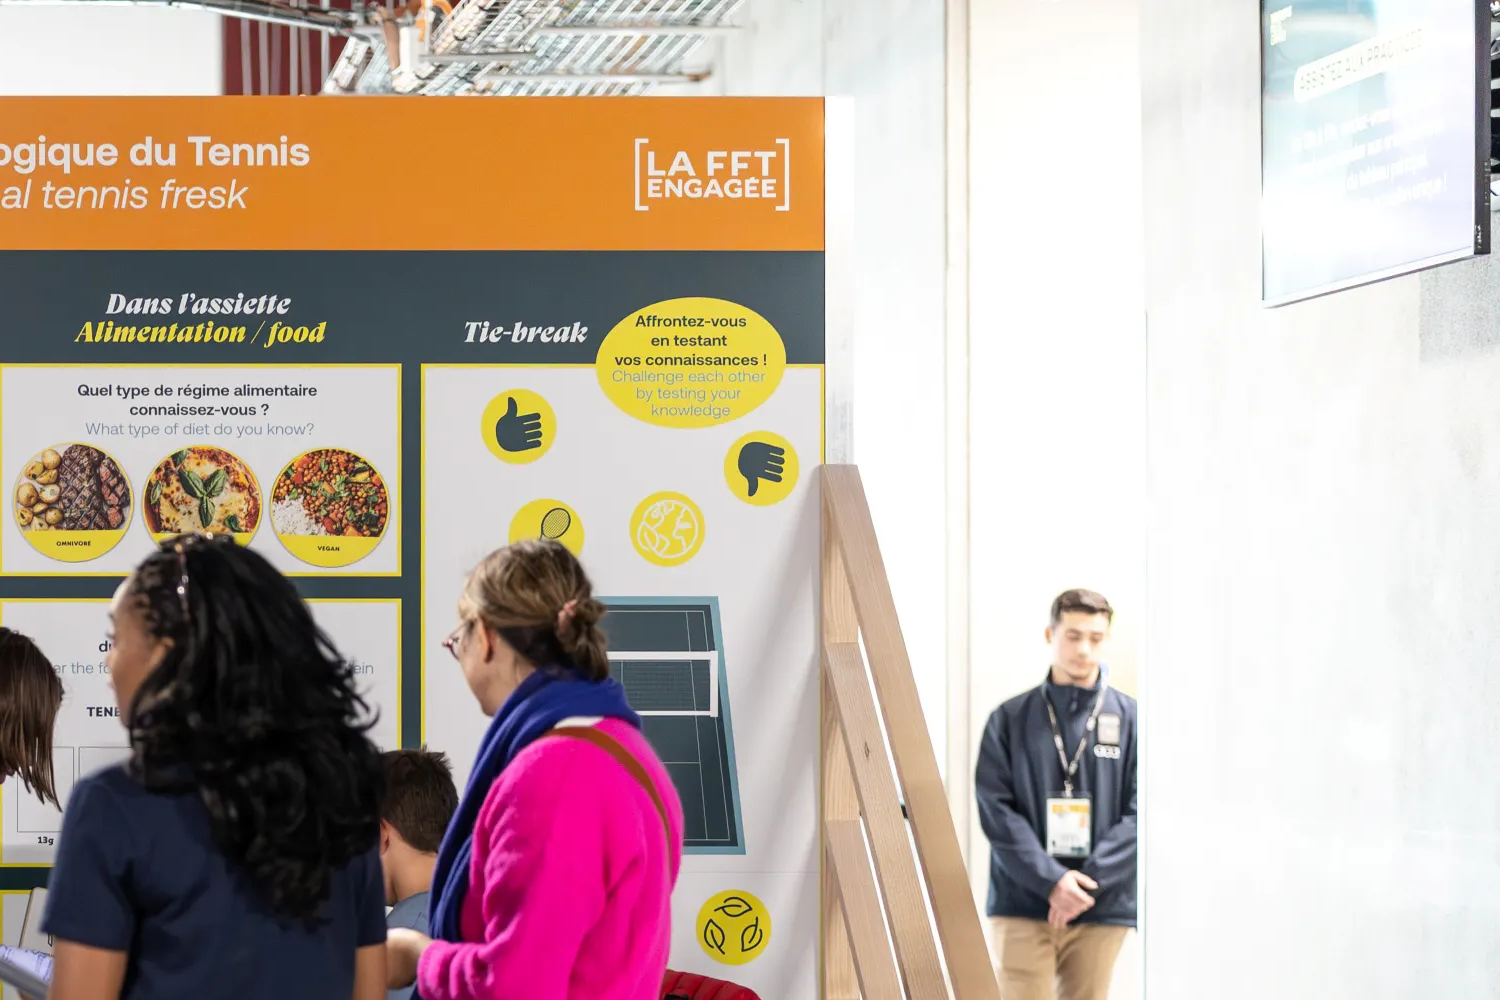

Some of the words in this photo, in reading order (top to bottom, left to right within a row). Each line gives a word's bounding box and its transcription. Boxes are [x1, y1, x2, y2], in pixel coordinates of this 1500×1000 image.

[129, 135, 176, 167] du
[187, 135, 310, 167] Tennis
[647, 151, 697, 176] LA
[706, 151, 777, 176] FFT
[41, 178, 149, 210] tennis
[160, 178, 249, 210] fresk
[647, 176, 777, 198] ENGAGÉE
[106, 293, 173, 316] Dans
[634, 314, 747, 328] Affrontez-vous
[75, 322, 246, 345] Alimentation
[264, 321, 326, 348] food
[464, 321, 589, 343] Tie-break
[650, 337, 670, 347] en
[673, 334, 728, 347] testant
[614, 356, 642, 366] vos
[645, 353, 759, 366] connaissances
[611, 369, 684, 384] Challenge
[688, 369, 724, 383] each
[728, 370, 766, 383] other
[77, 383, 113, 397] Quel
[115, 384, 150, 400] type
[153, 384, 174, 397] de
[177, 383, 230, 400] régime
[233, 383, 318, 397] alimentaire
[636, 387, 653, 403] by
[657, 387, 707, 402] testing
[710, 389, 742, 402] your
[129, 402, 257, 416] connaissez-vous
[260, 403, 270, 416] ?
[651, 403, 730, 418] knowledge
[85, 422, 125, 436] What
[127, 423, 160, 438] type
[164, 422, 179, 436] of
[182, 422, 210, 436] diet
[213, 422, 233, 436] do
[236, 425, 263, 438] you
[267, 422, 315, 436] know?
[71, 661, 94, 675] the
[37, 836, 55, 846] 13g
